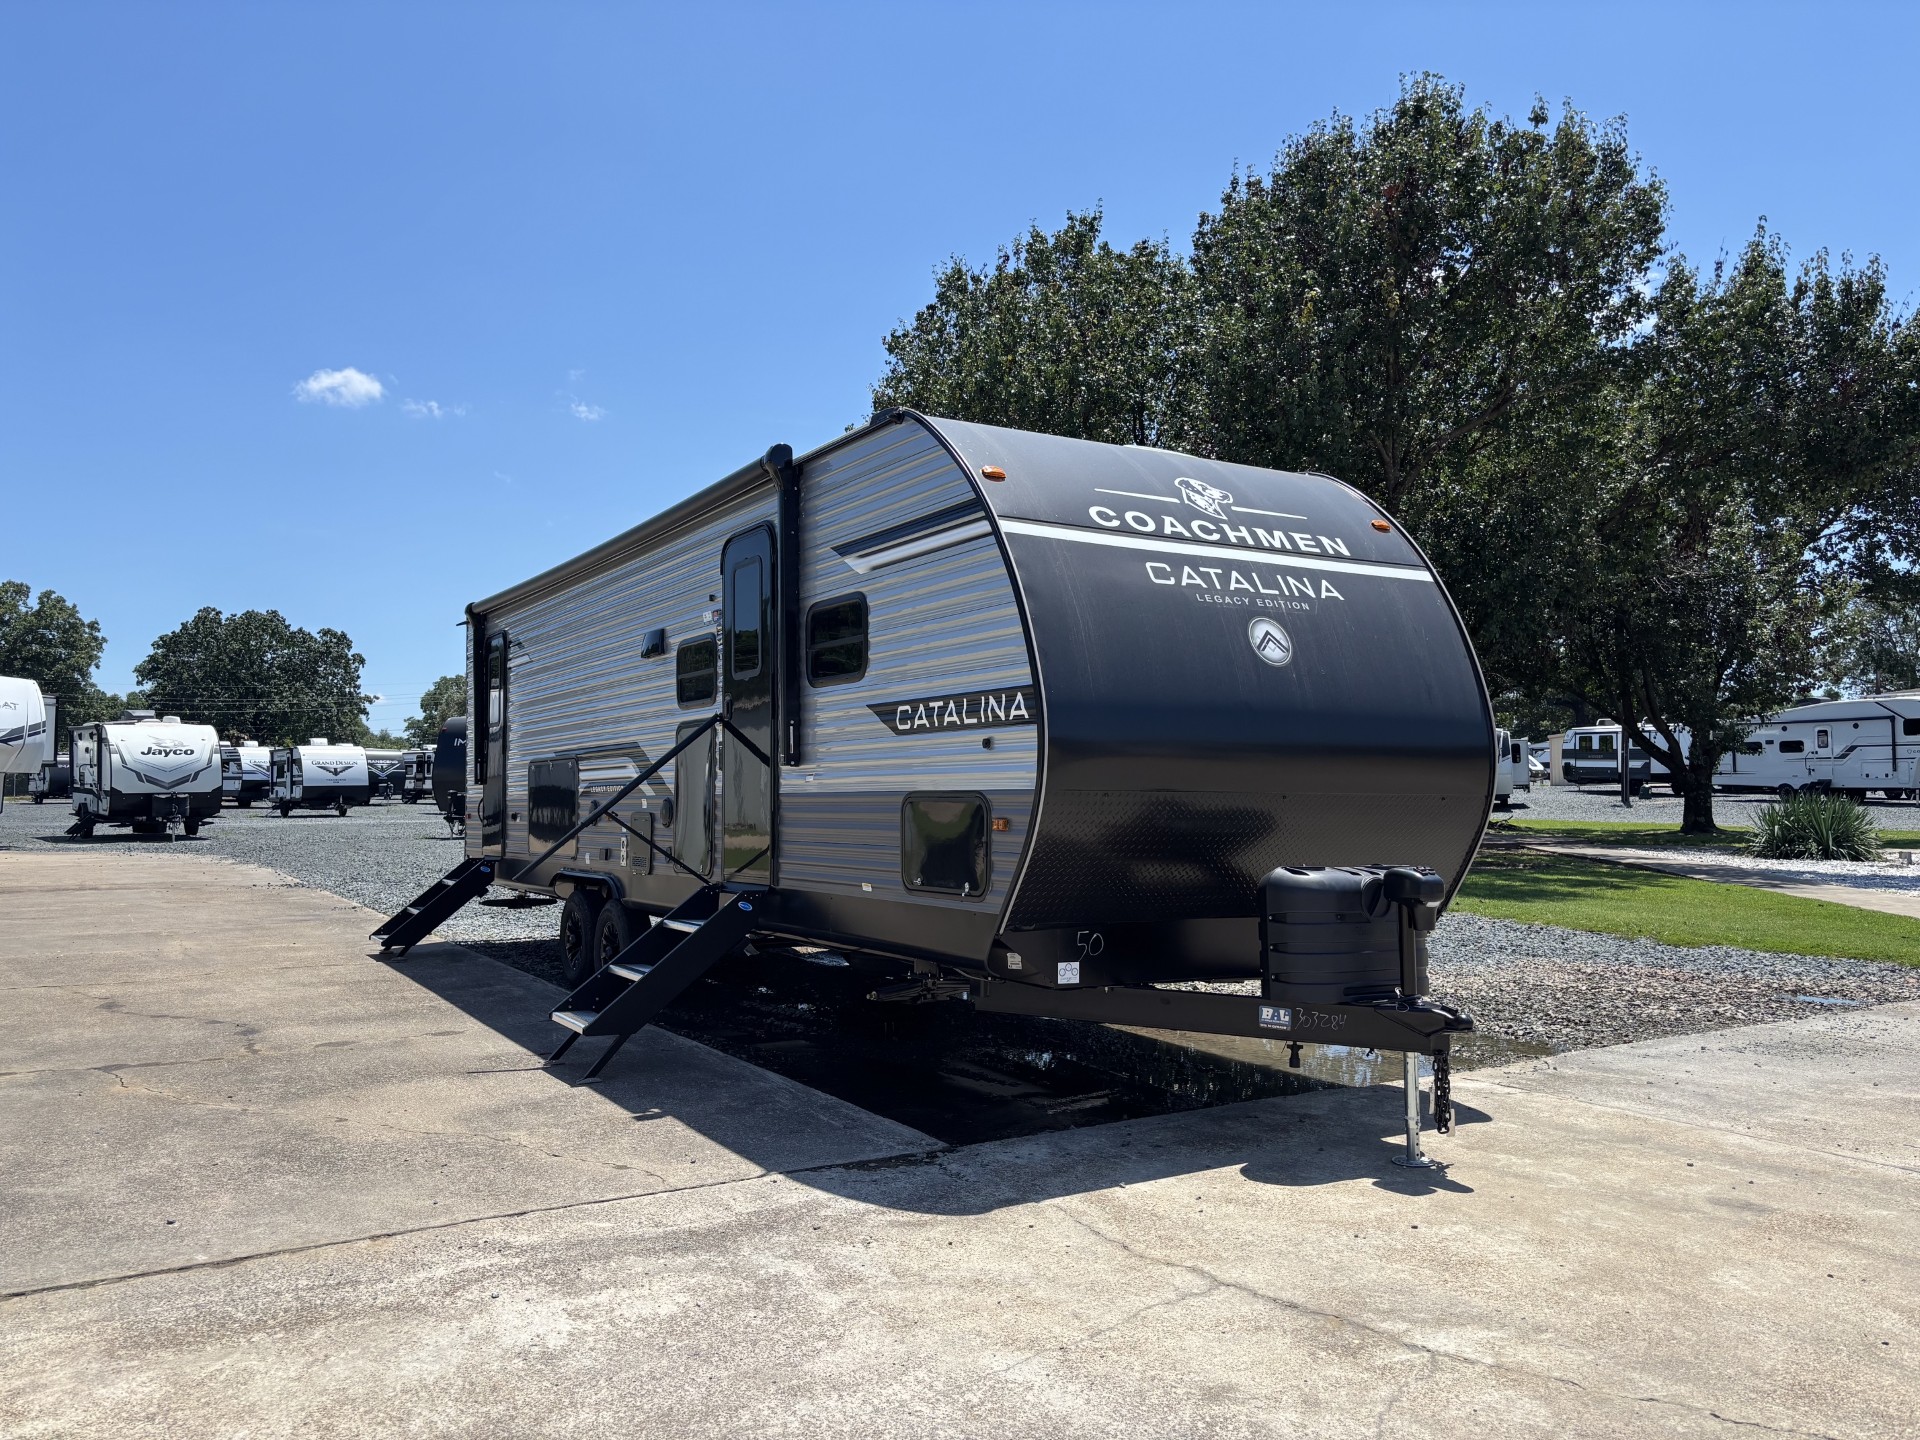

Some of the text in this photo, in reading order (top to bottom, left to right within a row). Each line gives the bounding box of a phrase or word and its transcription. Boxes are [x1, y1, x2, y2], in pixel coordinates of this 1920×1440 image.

[1088, 505, 1351, 556] COACHMEN
[1145, 561, 1345, 601] CATALINA
[1195, 593, 1310, 611] LEGACY EDITION
[0, 701, 20, 711] AT
[896, 691, 1029, 730] CATALINA
[140, 746, 195, 758] Jayco
[1076, 930, 1105, 962] 50
